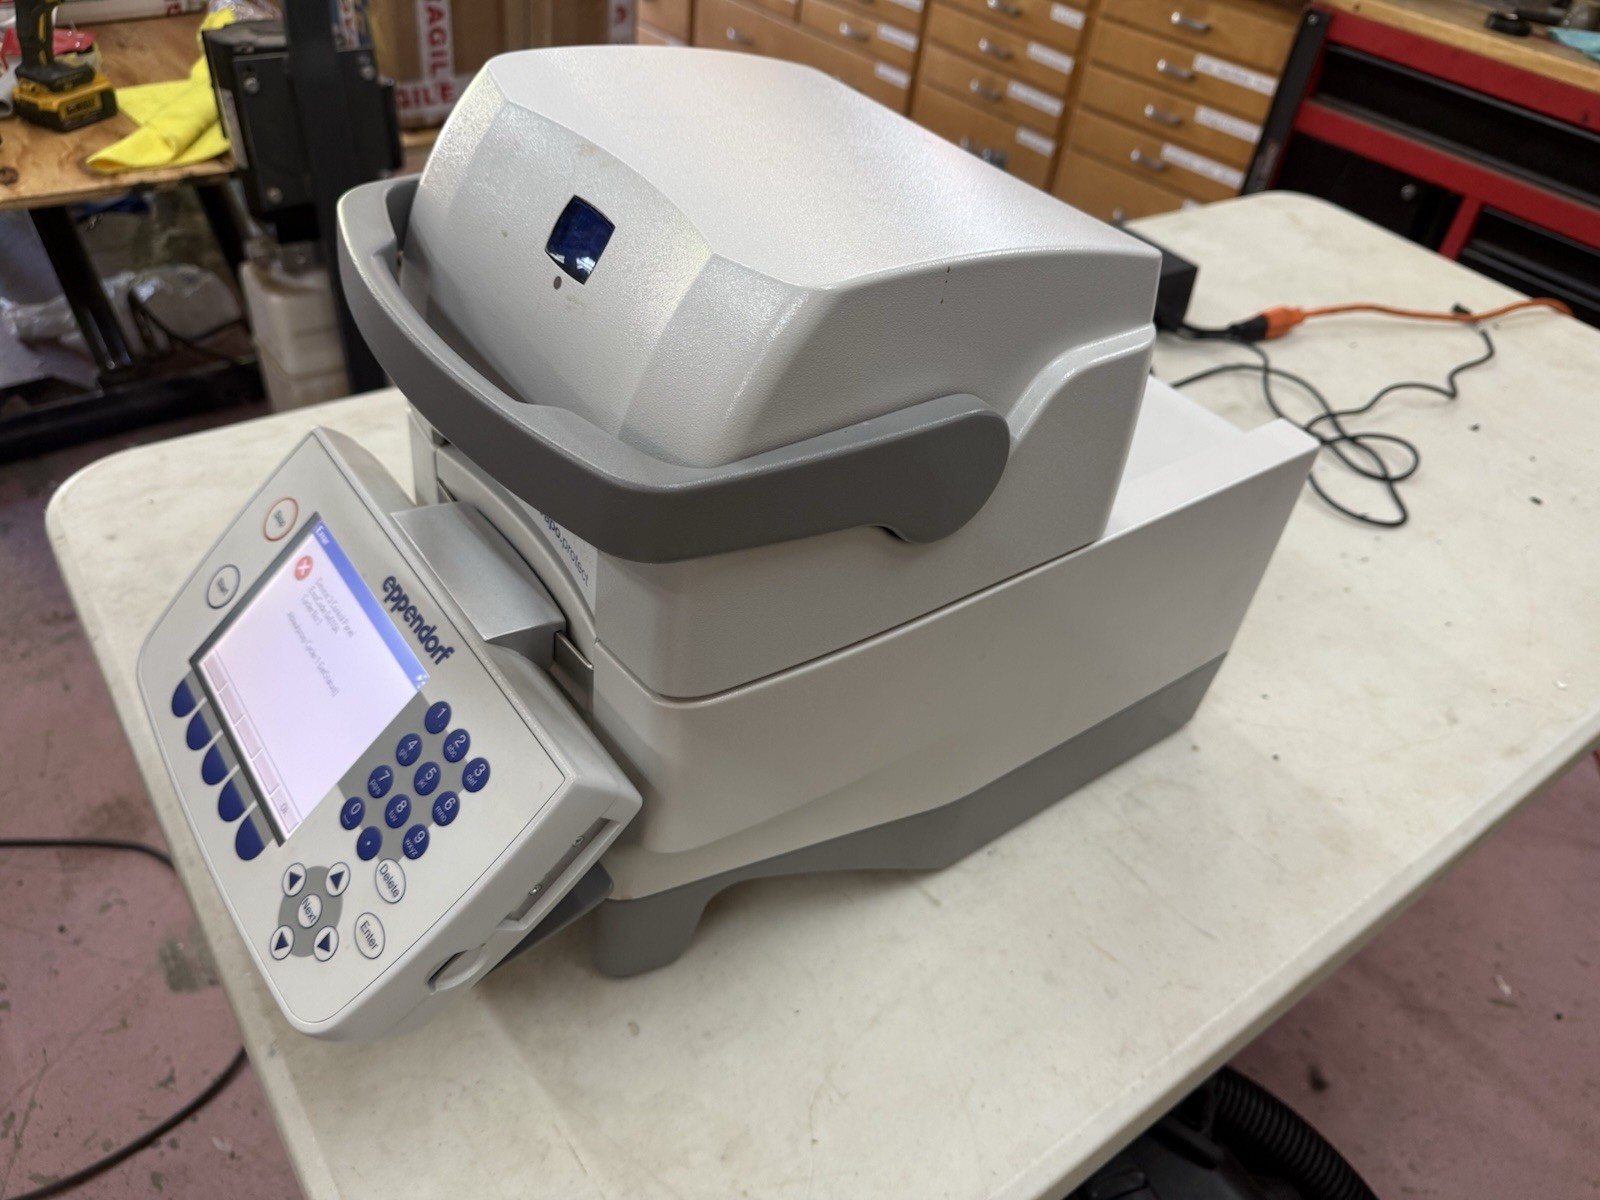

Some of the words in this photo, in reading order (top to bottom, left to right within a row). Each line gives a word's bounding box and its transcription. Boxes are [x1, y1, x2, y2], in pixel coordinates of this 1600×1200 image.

[541, 513, 589, 587] apo.protect
[382, 576, 455, 665] eppendorf
[437, 707, 447, 718] 1
[407, 739, 419, 751] 4
[454, 734, 467, 748] 2
[378, 770, 391, 781] 7
[425, 767, 437, 780] 5
[474, 763, 486, 777] 3
[351, 803, 361, 815] 0
[396, 800, 408, 813] 8
[444, 797, 456, 811] 6
[414, 830, 426, 844] 9
[379, 863, 400, 898] Delete
[301, 897, 317, 924] Next
[360, 920, 379, 950] Enter
